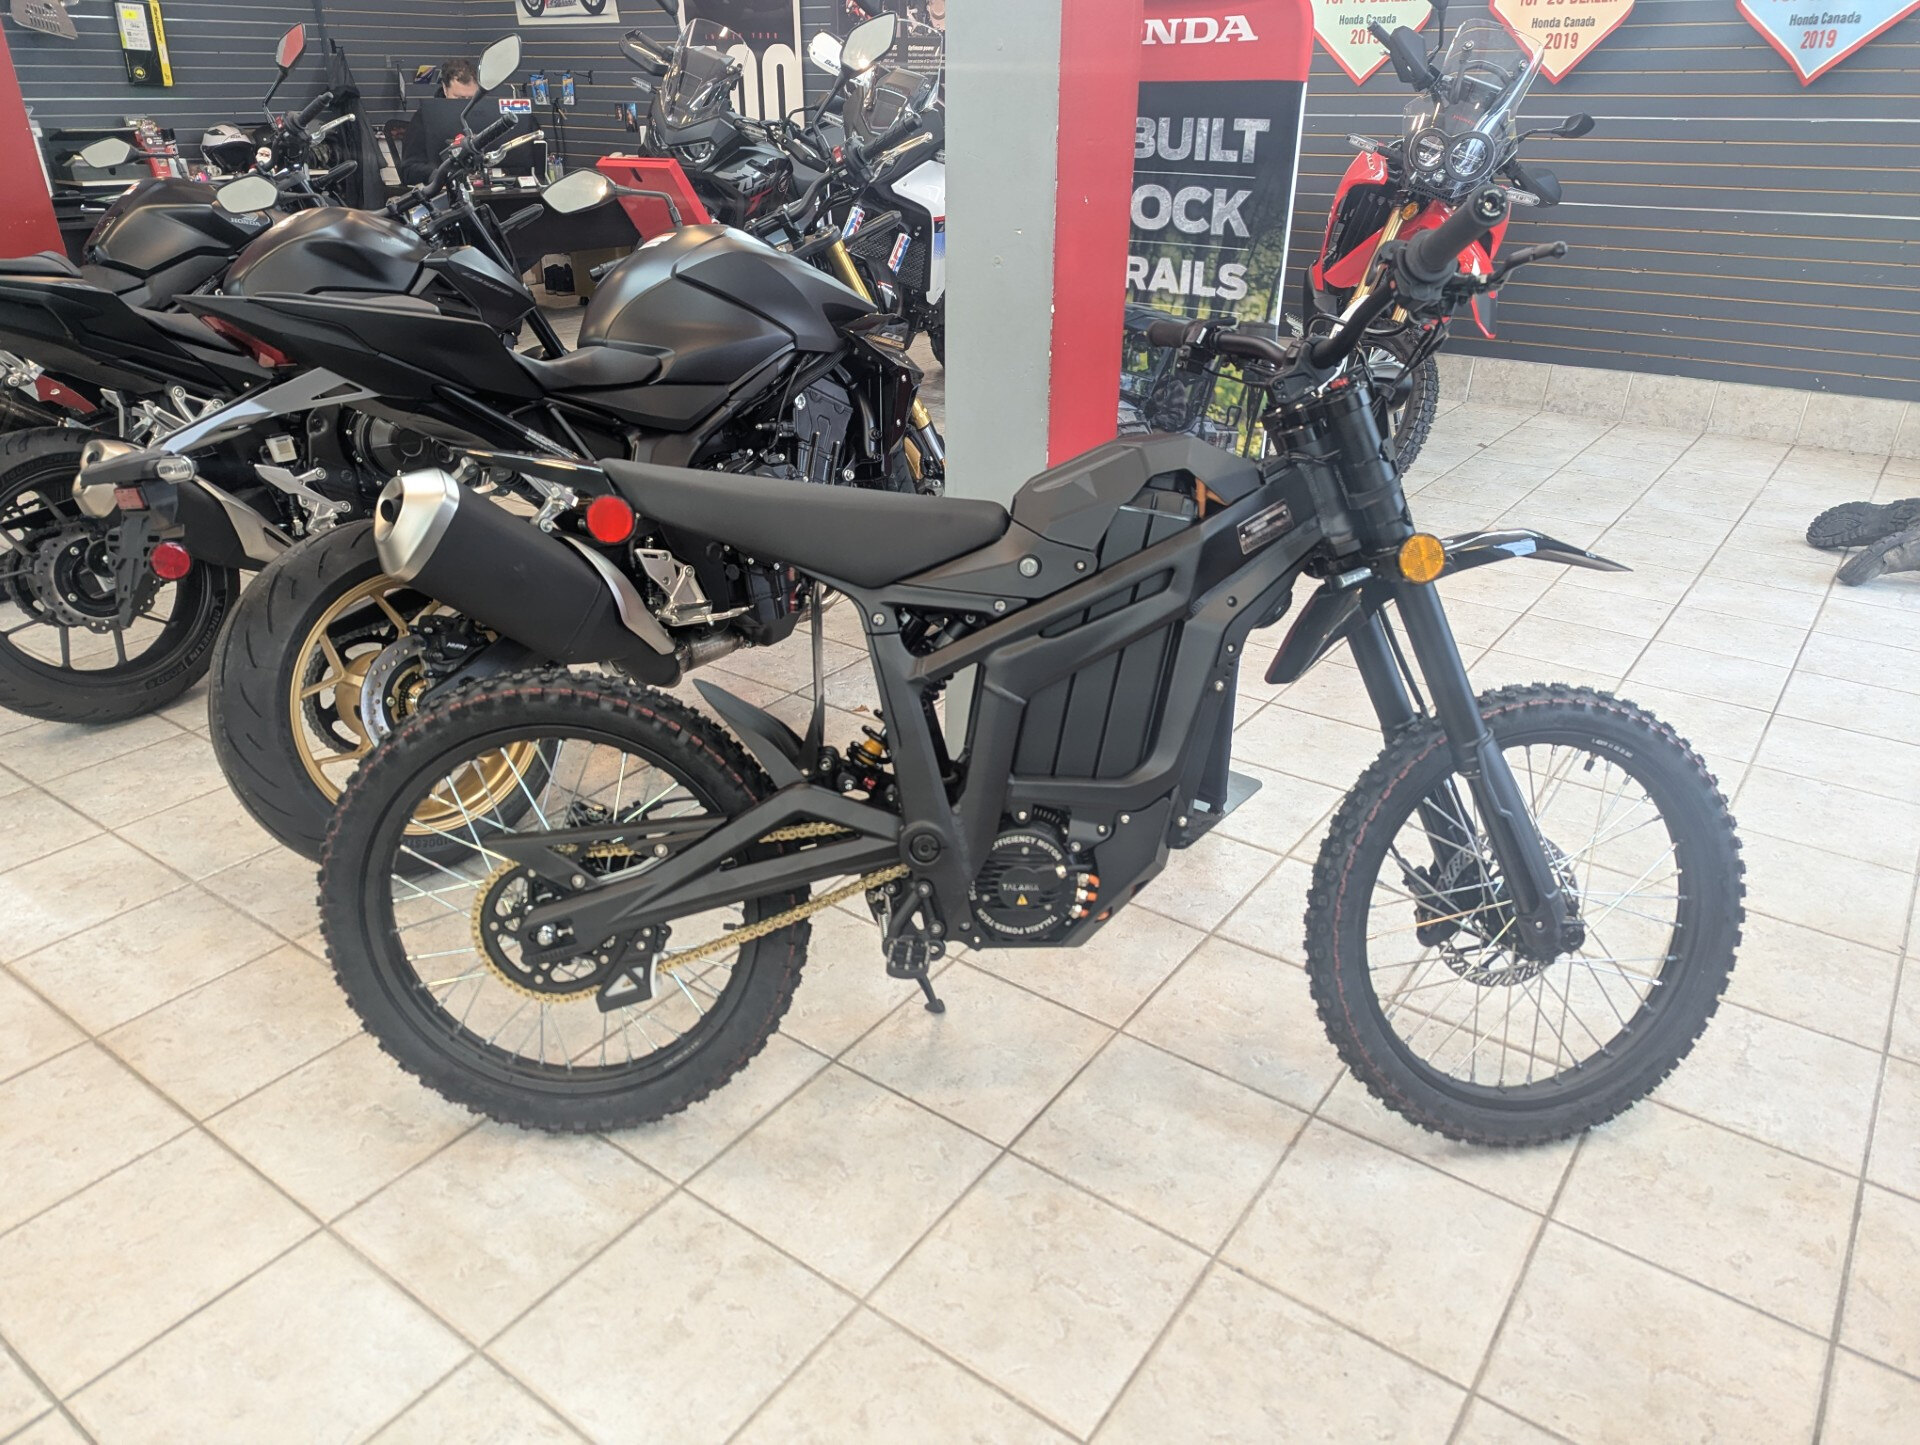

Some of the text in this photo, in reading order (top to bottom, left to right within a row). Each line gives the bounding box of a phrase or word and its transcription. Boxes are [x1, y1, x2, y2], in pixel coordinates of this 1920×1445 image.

[1339, 13, 1397, 26] Honda Canada
[1531, 16, 1596, 28] Honda Canada
[1789, 11, 1862, 26] Honda Canada
[1141, 14, 1259, 45] NDA
[1800, 29, 1837, 49] 2019
[1544, 32, 1579, 50] 2019
[1133, 116, 1271, 164] BUILT
[1366, 152, 1376, 171] ALLY
[1130, 183, 1253, 238] OCK
[230, 217, 262, 227] HONDA
[1125, 255, 1249, 300] RAILS
[1037, 839, 1062, 861] MOTOR
[1002, 883, 1040, 892] TALARIA
[1025, 914, 1058, 934] TALARIA
